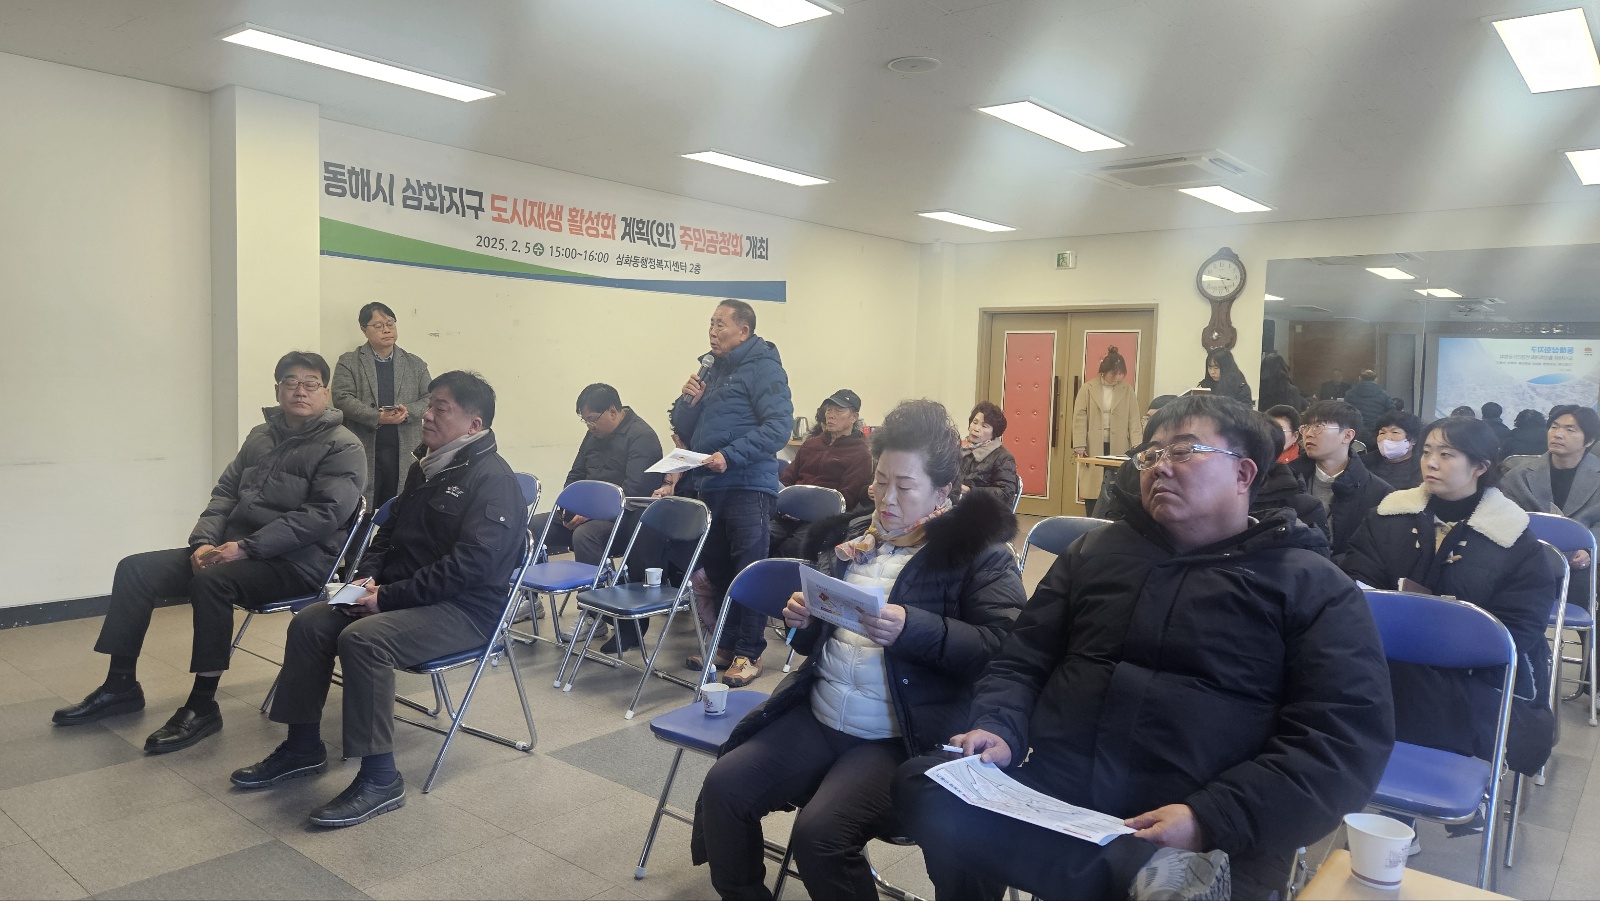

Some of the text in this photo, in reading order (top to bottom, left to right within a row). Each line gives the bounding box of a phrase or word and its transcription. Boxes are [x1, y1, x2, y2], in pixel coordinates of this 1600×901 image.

[323, 161, 769, 261] 동해시 삼화지구 도시재생 활성화 계획(안) 주민공청회 개최
[475, 235, 508, 251] 2025.
[511, 240, 521, 253] 2.
[549, 245, 610, 263] 15:00~16:00
[615, 253, 687, 273] 삼화동행정복지센터
[689, 263, 701, 275] 2층
